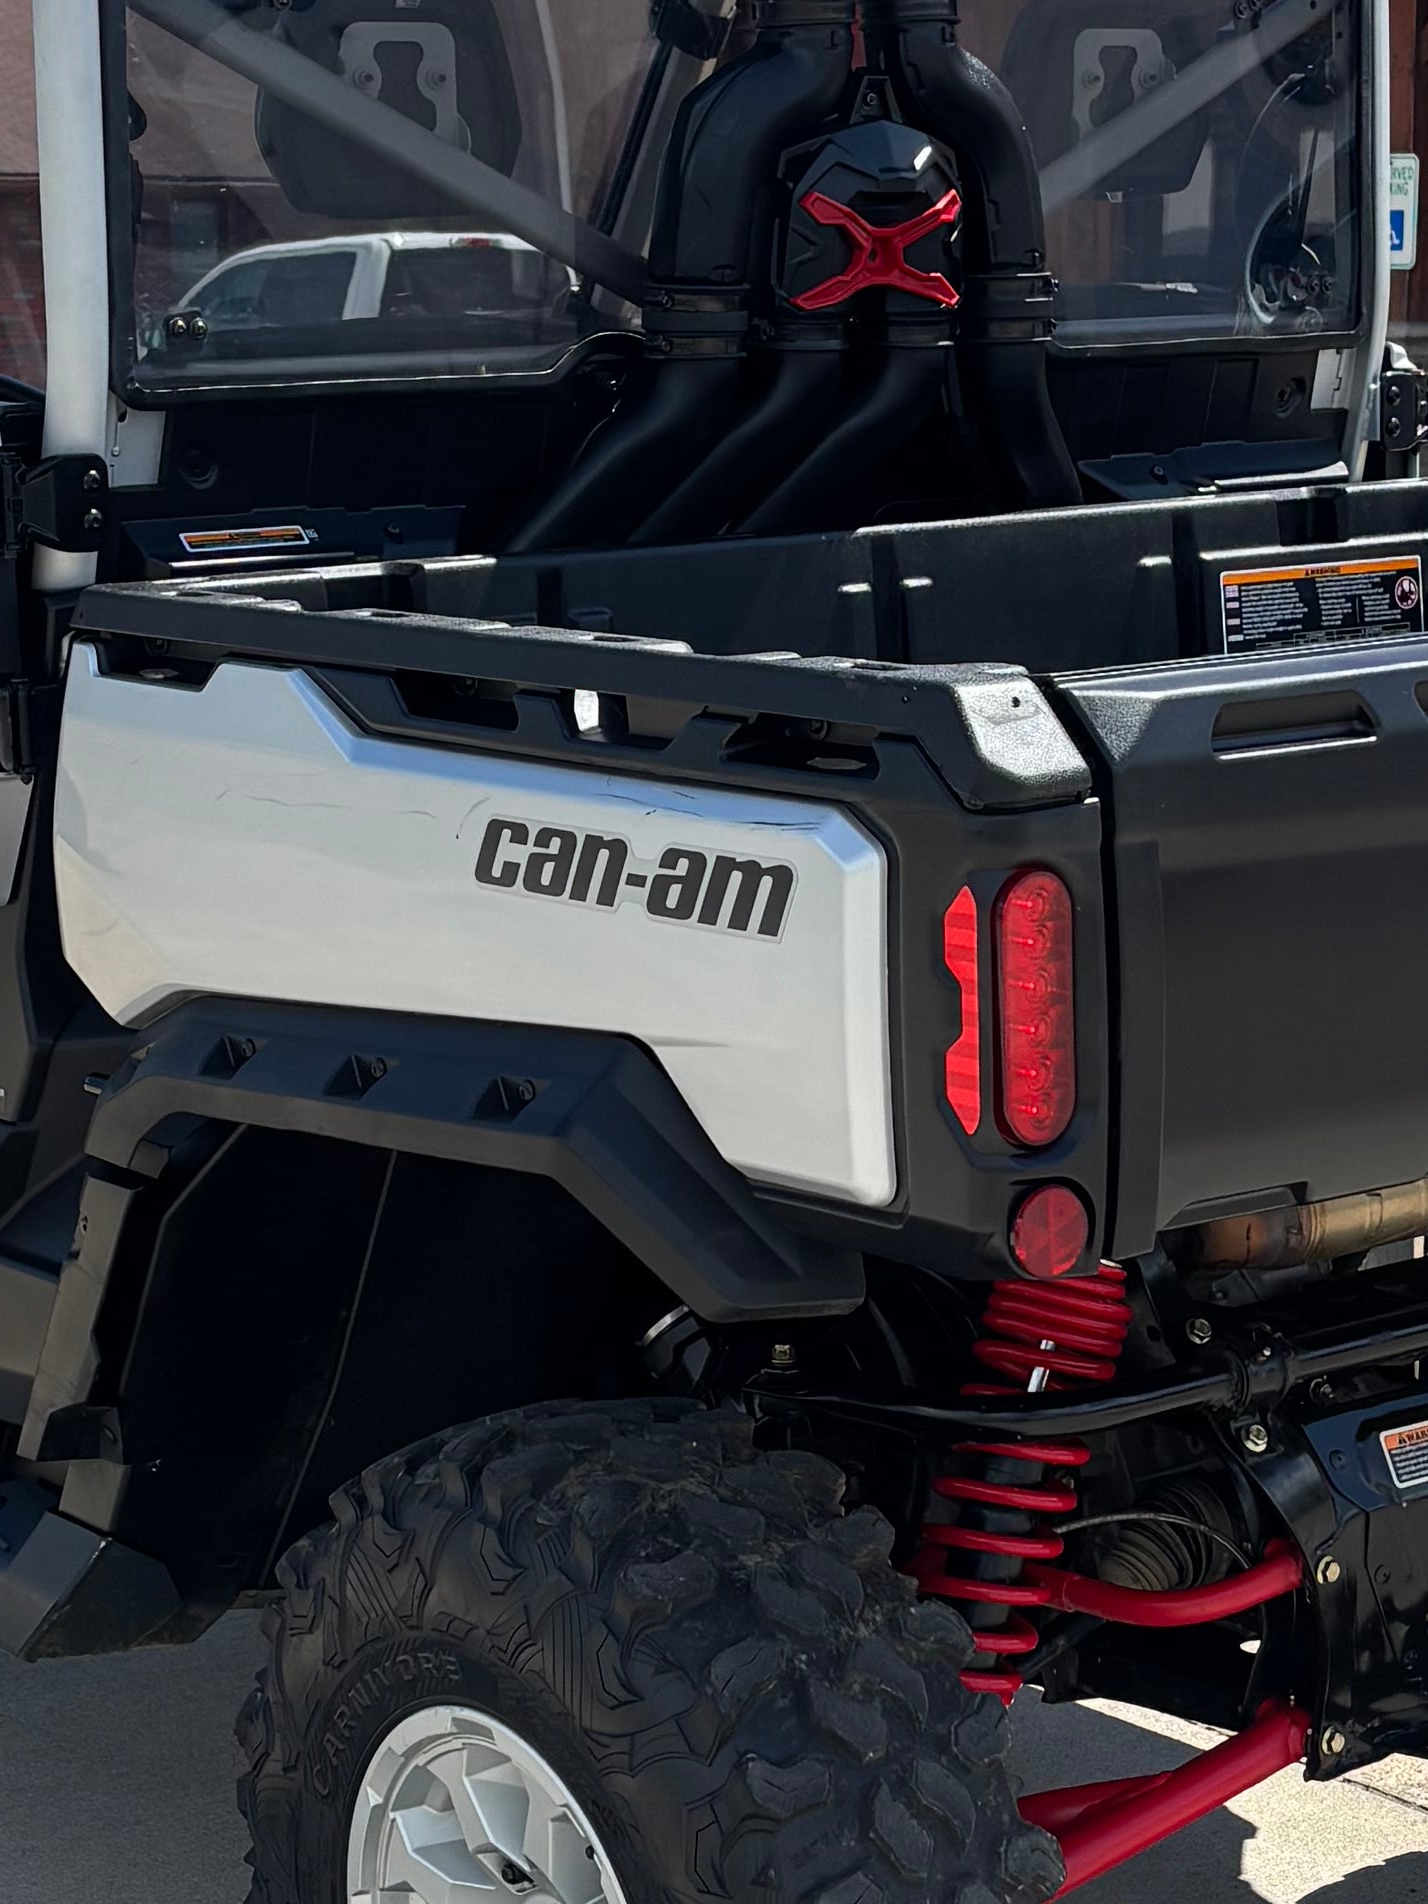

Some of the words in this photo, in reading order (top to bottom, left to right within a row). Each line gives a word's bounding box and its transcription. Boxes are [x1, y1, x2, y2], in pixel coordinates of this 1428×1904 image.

[1390, 166, 1414, 180] RVED
[1390, 181, 1409, 196] KING
[474, 818, 795, 938] can-am
[312, 1650, 462, 1796] CARNIVORE
